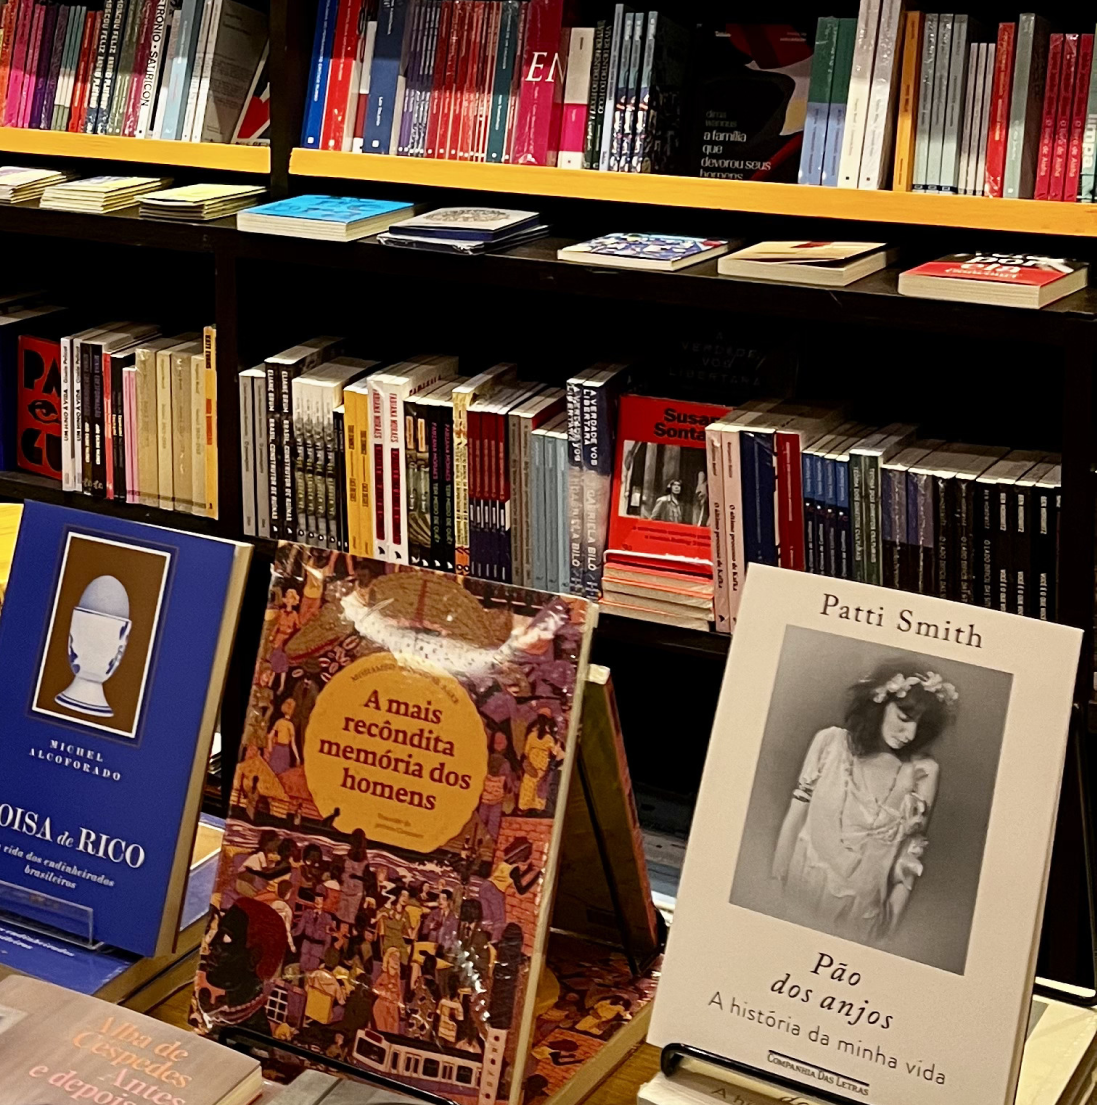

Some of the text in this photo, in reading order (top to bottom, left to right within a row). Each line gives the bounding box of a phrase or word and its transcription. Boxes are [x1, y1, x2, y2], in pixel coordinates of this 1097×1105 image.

[99, 31, 109, 53] FELIZ
[109, 31, 120, 53] FELIZ
[702, 144, 723, 155] que
[711, 130, 746, 142] família
[701, 158, 771, 170] devorou seus
[654, 422, 705, 441] Sonta
[283, 445, 293, 497] CONSTRUTOR DE
[820, 593, 984, 649] Patti Smith
[364, 689, 443, 724] A mais
[50, 739, 104, 762] MICHEL
[342, 716, 455, 757] recôndita
[29, 748, 122, 781] ALCOFORADO
[318, 739, 472, 790] memória dos
[340, 767, 437, 811] homens
[3, 844, 24, 858] vida
[25, 851, 42, 864] dos
[44, 855, 115, 887] endinheirados
[57, 831, 74, 848] de
[76, 827, 145, 869] RICO
[24, 865, 77, 889] brasileiros
[810, 951, 862, 986] Pão
[771, 973, 894, 1030] dos anjos
[99, 1016, 189, 1062] Alba de
[708, 991, 946, 1085] A história da minha vida
[28, 1064, 49, 1078] e
[98, 1066, 187, 1105] Antes
